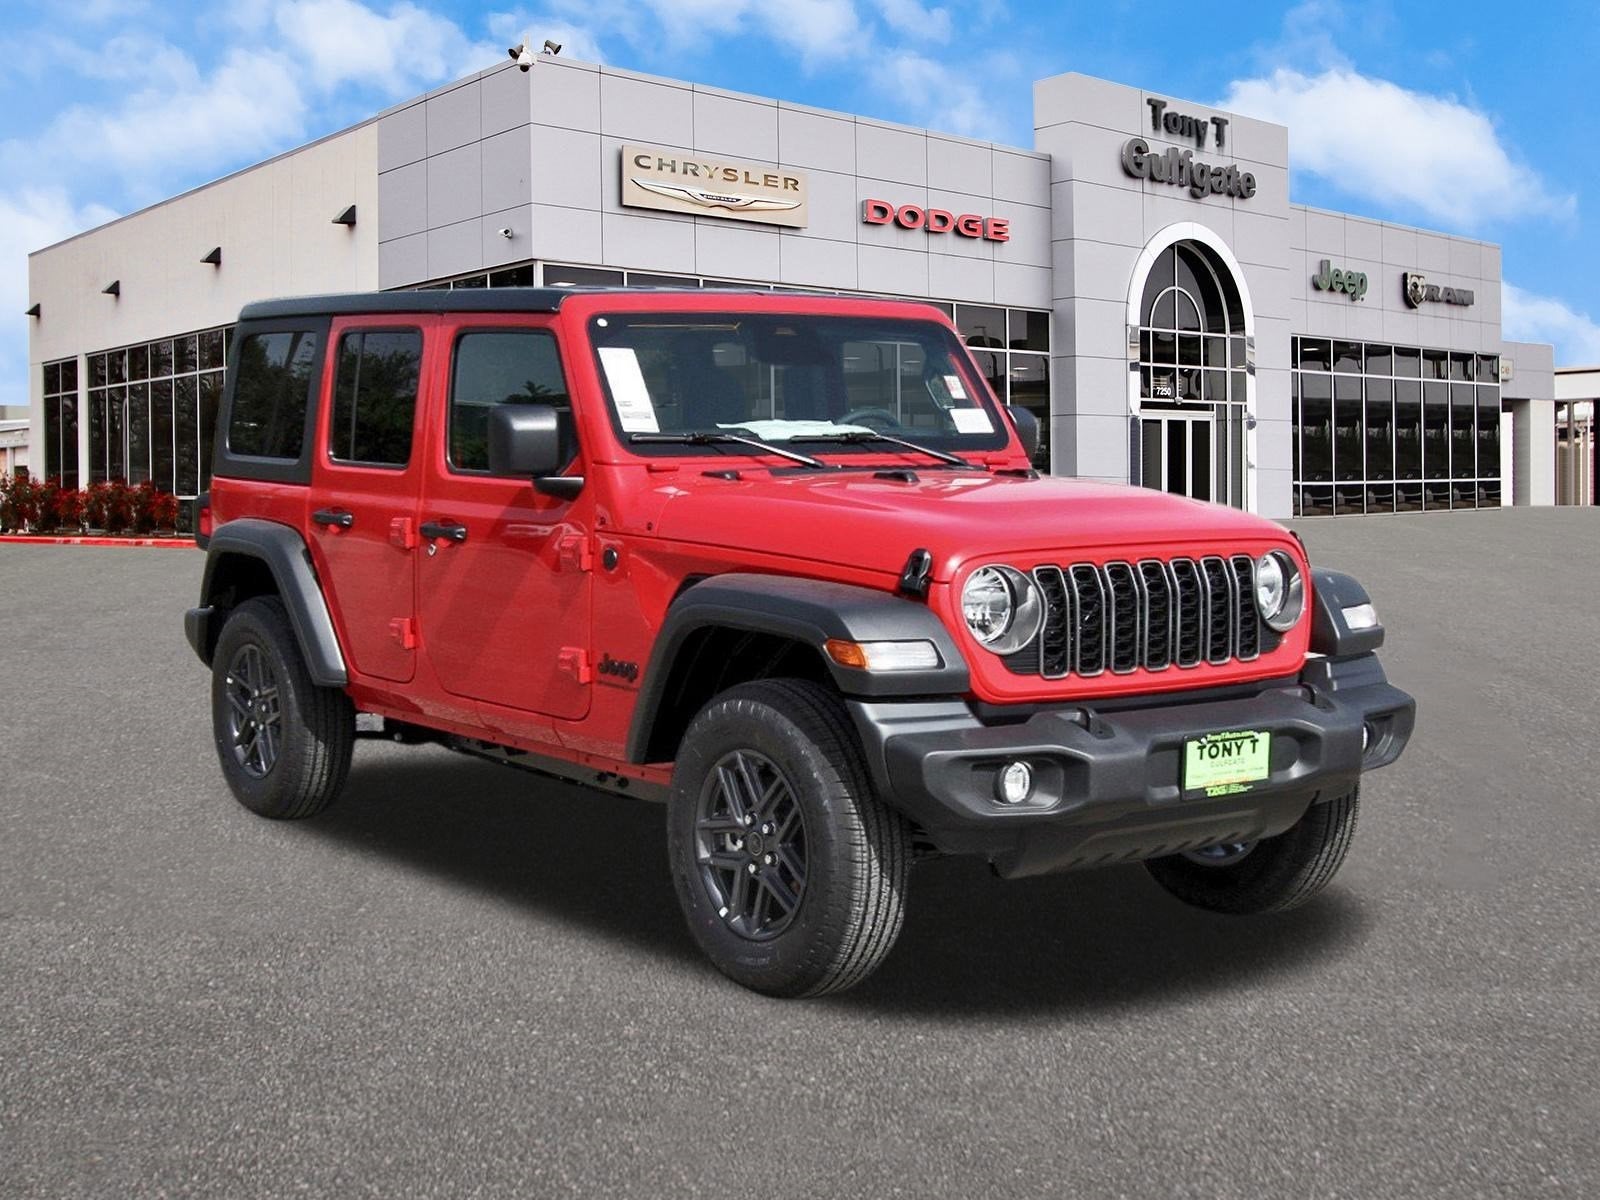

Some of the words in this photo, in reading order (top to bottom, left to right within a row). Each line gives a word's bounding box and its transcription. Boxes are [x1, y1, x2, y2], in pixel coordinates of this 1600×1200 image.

[1147, 98, 1208, 148] Tony
[1210, 116, 1229, 148] T
[634, 154, 800, 192] CHRYSLER
[1121, 137, 1257, 199] Gulfgate
[862, 198, 1010, 242] DODGE
[1311, 259, 1368, 301] Jeep
[1425, 283, 1475, 307] RAM
[597, 652, 639, 683] Jeep
[1197, 740, 1245, 760] TONY
[1250, 738, 1259, 754] T
